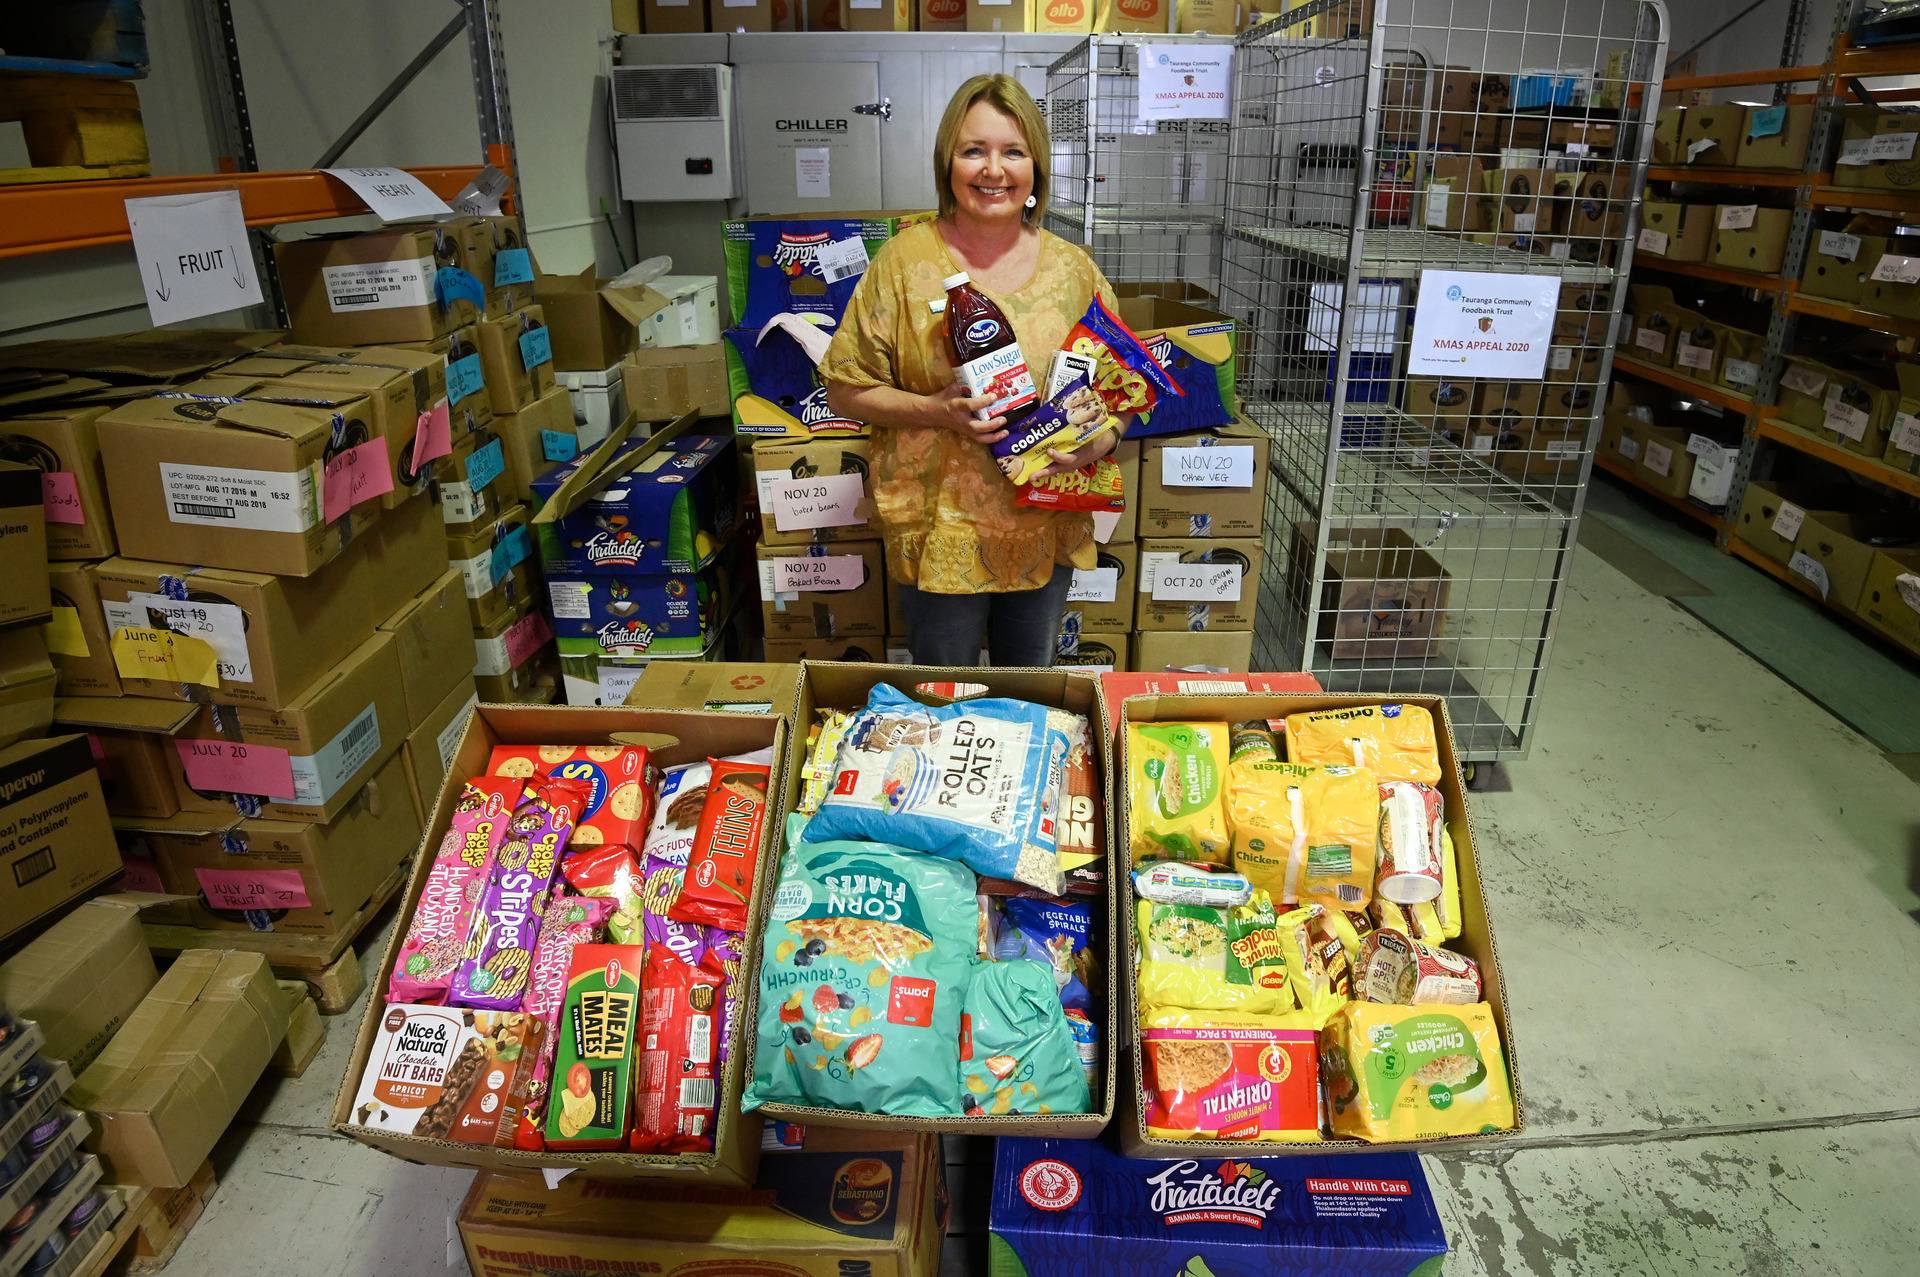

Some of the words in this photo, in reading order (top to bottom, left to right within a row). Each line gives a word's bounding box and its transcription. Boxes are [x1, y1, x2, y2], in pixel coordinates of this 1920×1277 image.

[1050, 6, 1077, 18] alto
[1192, 60, 1220, 68] Community
[1154, 92, 1176, 100] XMAS
[1178, 92, 1206, 100] APPEAL
[1207, 92, 1224, 100] 2020
[776, 120, 848, 130] CHILLER
[373, 184, 416, 198] HEAVY
[1824, 240, 1836, 249] OCT
[178, 250, 224, 276] FRUIT
[356, 278, 367, 286] AUG
[402, 274, 418, 282] 07:23
[1462, 296, 1492, 304] Tauranga
[1494, 298, 1532, 306] Community
[1496, 308, 1513, 316] Trust
[1433, 339, 1464, 350] XMAS
[1466, 341, 1503, 351] APPEAL
[1506, 342, 1530, 352] 2020
[1066, 358, 1090, 370] penati
[1000, 366, 1025, 380] CRANBERRY
[1011, 417, 1062, 454] cookies
[348, 450, 358, 466] 20
[1182, 454, 1214, 470] NOV
[1216, 456, 1233, 470] 20
[168, 472, 183, 480] UPC
[186, 473, 218, 482] 92008-272
[220, 476, 231, 484] Soft
[238, 478, 253, 486] Moist
[1182, 474, 1206, 482] Other
[1209, 474, 1230, 482] VEG
[170, 482, 201, 492] LOT-MFG
[206, 485, 220, 494] AUG
[222, 486, 230, 494] 17
[230, 487, 247, 496] 2016
[250, 490, 258, 498] M
[270, 491, 290, 501] 16:52
[784, 488, 810, 500] NOV
[813, 486, 828, 499] 20
[191, 494, 218, 503] BEFORE
[226, 498, 234, 506] 17
[235, 499, 250, 508] AUG
[250, 500, 268, 510] 2018
[791, 503, 814, 516] baked
[818, 502, 840, 512] beans
[584, 532, 645, 563] Frutadeli
[785, 564, 810, 573] NOV
[813, 563, 826, 572] 20
[1798, 560, 1810, 571] OCT
[1811, 568, 1822, 578] 20
[788, 576, 812, 588] Baked
[814, 576, 841, 586] Beans
[1164, 578, 1186, 587] OCT
[1190, 578, 1203, 588] 20
[1210, 568, 1233, 586] CREAM
[1216, 577, 1234, 595] CORN
[191, 608, 207, 622] 19
[198, 620, 214, 633] 20
[124, 628, 158, 642] June
[597, 620, 655, 650] Frutadeli
[138, 650, 174, 663] Fruit
[192, 744, 222, 756] JULY
[230, 746, 248, 758] 20
[938, 720, 976, 808] ROLLED
[966, 737, 996, 796] OATS
[1186, 754, 1202, 805] Chicken
[19, 790, 90, 828] Polypropylene
[18, 816, 70, 847] Container
[708, 796, 756, 858] THINS
[713, 815, 724, 834] CHOC
[460, 832, 475, 866] Bear
[473, 822, 494, 868] Cookie
[526, 843, 542, 880] Bear
[538, 832, 559, 880] Cookie
[1236, 850, 1279, 866] Chicken
[214, 884, 240, 896] JULY
[248, 884, 264, 896] 20
[826, 875, 906, 902] FLAKES
[224, 896, 256, 906] FRUIT
[275, 890, 294, 901] 27
[438, 866, 470, 938] HUNDREDS
[418, 870, 448, 943] THOUSANDS
[492, 873, 533, 950] Stripes
[828, 892, 902, 920] CORN
[1038, 911, 1092, 925] VEGETABLE
[1049, 920, 1086, 934] SPIRALS
[1380, 938, 1406, 953] TRIDENT
[546, 930, 570, 1012] THOUSANDS
[1376, 959, 1392, 972] HOT
[530, 939, 554, 1016] HUNDREDS
[898, 986, 930, 998] pams
[86, 1032, 104, 1050] ROLL
[104, 1015, 120, 1032] BAG
[404, 1022, 433, 1039] Nice
[434, 1024, 447, 1040] &
[584, 996, 604, 1054] MATES
[604, 999, 630, 1056] MEAL
[1196, 1030, 1220, 1038] PACK
[1222, 1030, 1227, 1038] 5
[1229, 1030, 1273, 1040] ORIENTAL
[396, 1037, 448, 1056] Natural
[1406, 1033, 1464, 1054] Chicken
[397, 1053, 438, 1066] Chocolate
[1385, 1055, 1396, 1070] 5
[384, 1062, 410, 1080] NUT
[411, 1066, 444, 1083] BARS
[389, 1085, 427, 1096] APRICOT
[1203, 1081, 1272, 1116] ORIENTAL
[1224, 1110, 1244, 1123] NOODLES
[1244, 1104, 1266, 1116] MINUTE
[462, 1114, 470, 1128] 6
[1046, 1163, 1077, 1188] FRUTADELI
[1146, 1160, 1282, 1213] Frutadeli
[1310, 1180, 1350, 1191] Handle
[1352, 1181, 1378, 1192] With
[1380, 1182, 1408, 1192] Care
[838, 1189, 884, 1200] SEBASTIANO
[486, 1205, 502, 1213] KEEP
[489, 1197, 514, 1207] HANDLE
[514, 1200, 530, 1209] WITH
[530, 1202, 548, 1210] CARE
[1168, 1212, 1203, 1223] BANANAS,
[1210, 1212, 1232, 1220] Sweet
[1232, 1214, 1260, 1226] Passion
[476, 1244, 568, 1270] Premium
[568, 1255, 662, 1274] Bananas
